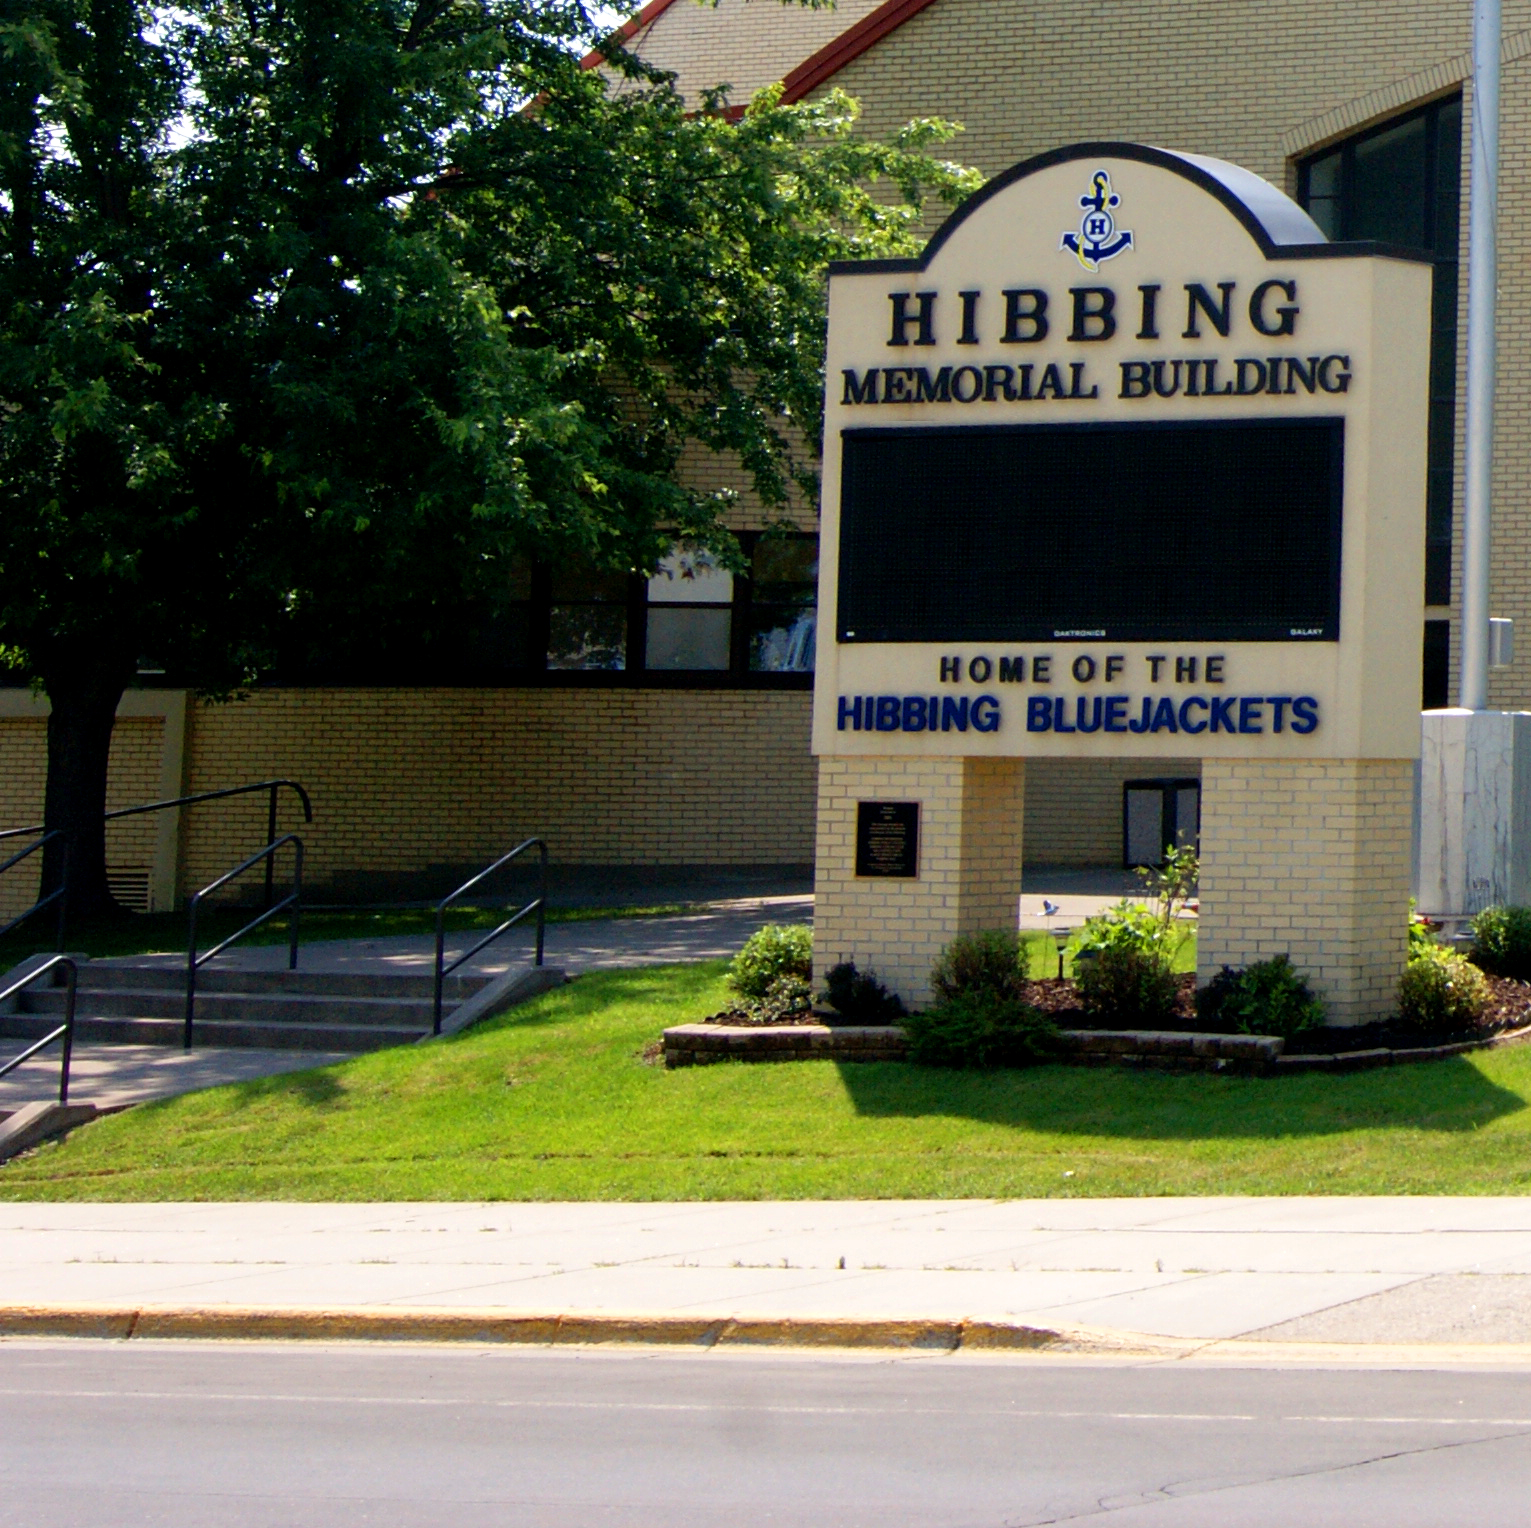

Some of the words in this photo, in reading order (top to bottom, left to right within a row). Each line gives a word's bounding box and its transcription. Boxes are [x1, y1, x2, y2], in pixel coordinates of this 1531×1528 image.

[1089, 218, 1106, 236] H
[887, 279, 1300, 347] HIBBING
[840, 362, 1098, 405] MEMORIAL
[1118, 355, 1352, 399] BUILDING
[1290, 628, 1323, 636] GALAXY
[938, 655, 1052, 684] HOME
[1072, 655, 1124, 683] OF
[1145, 655, 1226, 683] THE
[836, 695, 1001, 732] HIBBING
[1026, 695, 1320, 735] BLUEJACKETS
